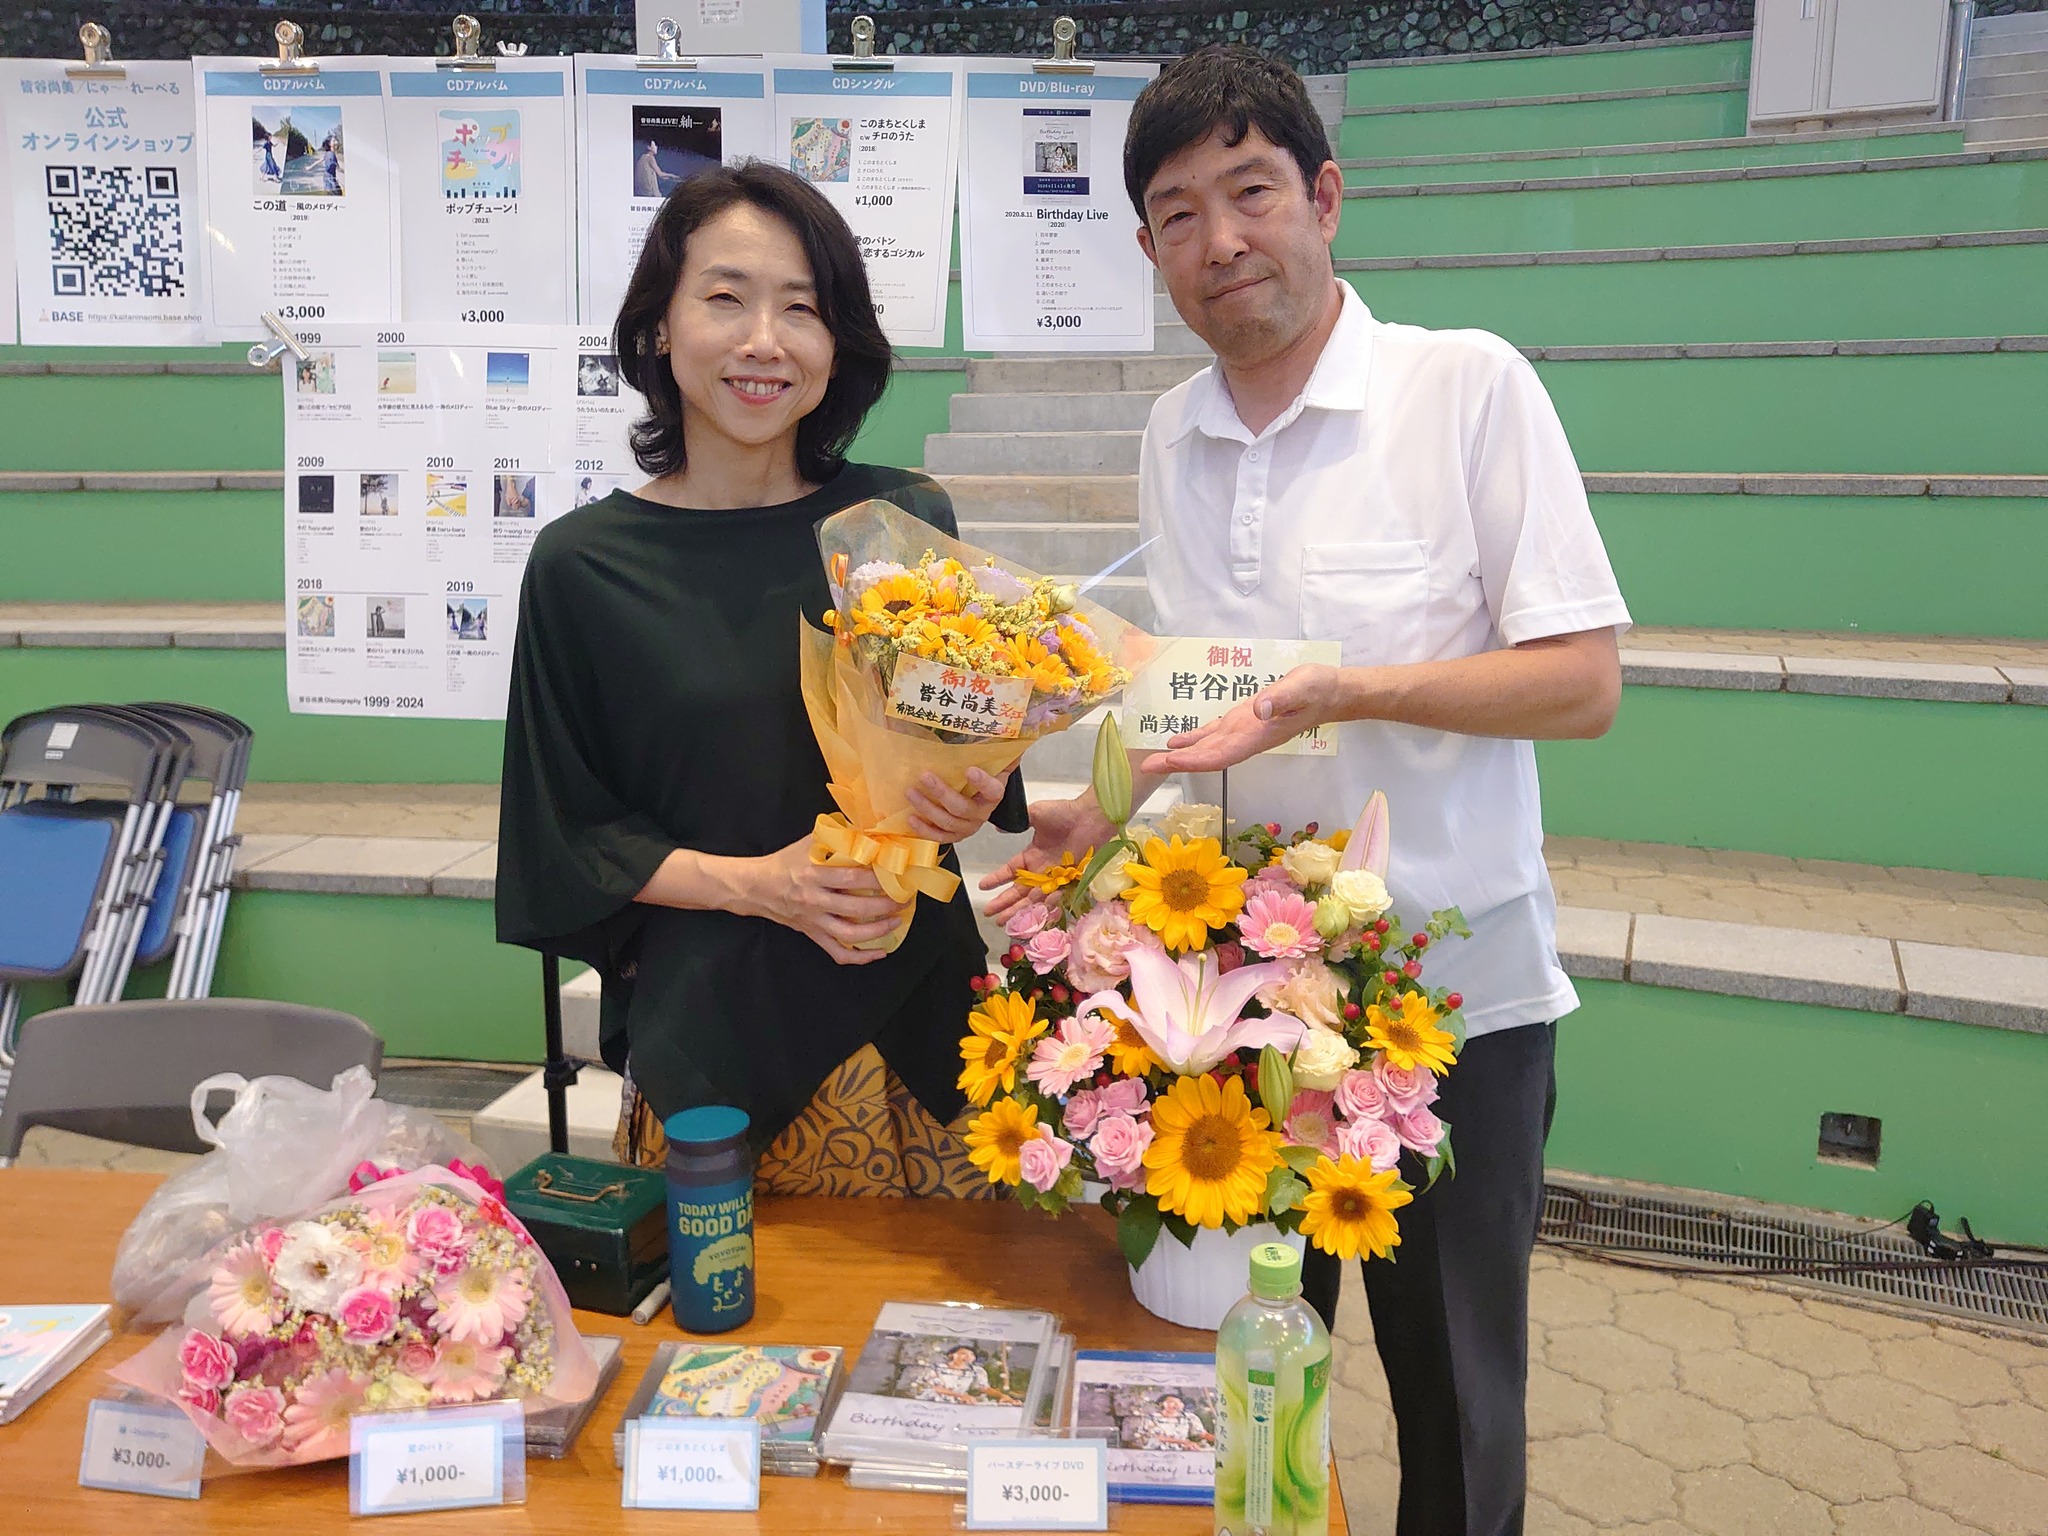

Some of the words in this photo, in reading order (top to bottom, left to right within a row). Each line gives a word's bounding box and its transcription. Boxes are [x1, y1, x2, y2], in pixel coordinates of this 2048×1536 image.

[264, 79, 325, 94] CDアルバム
[446, 79, 508, 93] CDアルバム
[644, 78, 707, 93] CDアルバム
[832, 77, 895, 92] CDシングル
[1019, 80, 1096, 98] DVD/Blu-ray
[85, 106, 128, 129] 公式
[860, 119, 926, 129] このまちとくしま
[22, 132, 195, 153] オンラインショップ
[872, 131, 915, 142] チロのうた
[253, 199, 287, 212] この道
[855, 195, 893, 208] ¥1,000
[1037, 209, 1083, 222] Birthday
[1086, 209, 1109, 220] Live
[863, 248, 925, 259] 恋するゴジカル
[52, 311, 84, 322] BASE
[278, 306, 325, 320] ¥3,000
[461, 310, 504, 323] ¥3,000
[1036, 315, 1082, 330] ¥3,000
[295, 333, 321, 343] 1999
[377, 332, 405, 343] 2000
[579, 336, 608, 347] 2004
[297, 456, 324, 468] 2009
[426, 457, 454, 468] 2010
[494, 458, 520, 469] 2011
[575, 459, 604, 470] 2012
[297, 578, 322, 589] 2018
[446, 581, 474, 592] 2019
[1207, 645, 1254, 667] 御祝
[939, 668, 994, 697] 御祝
[364, 696, 390, 708] 1999
[396, 697, 424, 709] 2024
[1310, 738, 1327, 750] より
[678, 1201, 717, 1217] TODAY
[718, 1195, 745, 1215] WILL
[679, 1215, 733, 1237] GOOD
[850, 1413, 945, 1433] Birthday
[1062, 1460, 1084, 1471] DVD
[1106, 1460, 1177, 1478] irthday
[1186, 1465, 1214, 1476] Liv
[396, 1465, 465, 1486] ¥1,000-
[657, 1465, 724, 1485] ¥1,000-
[1001, 1484, 1070, 1504] ¥3,000-
